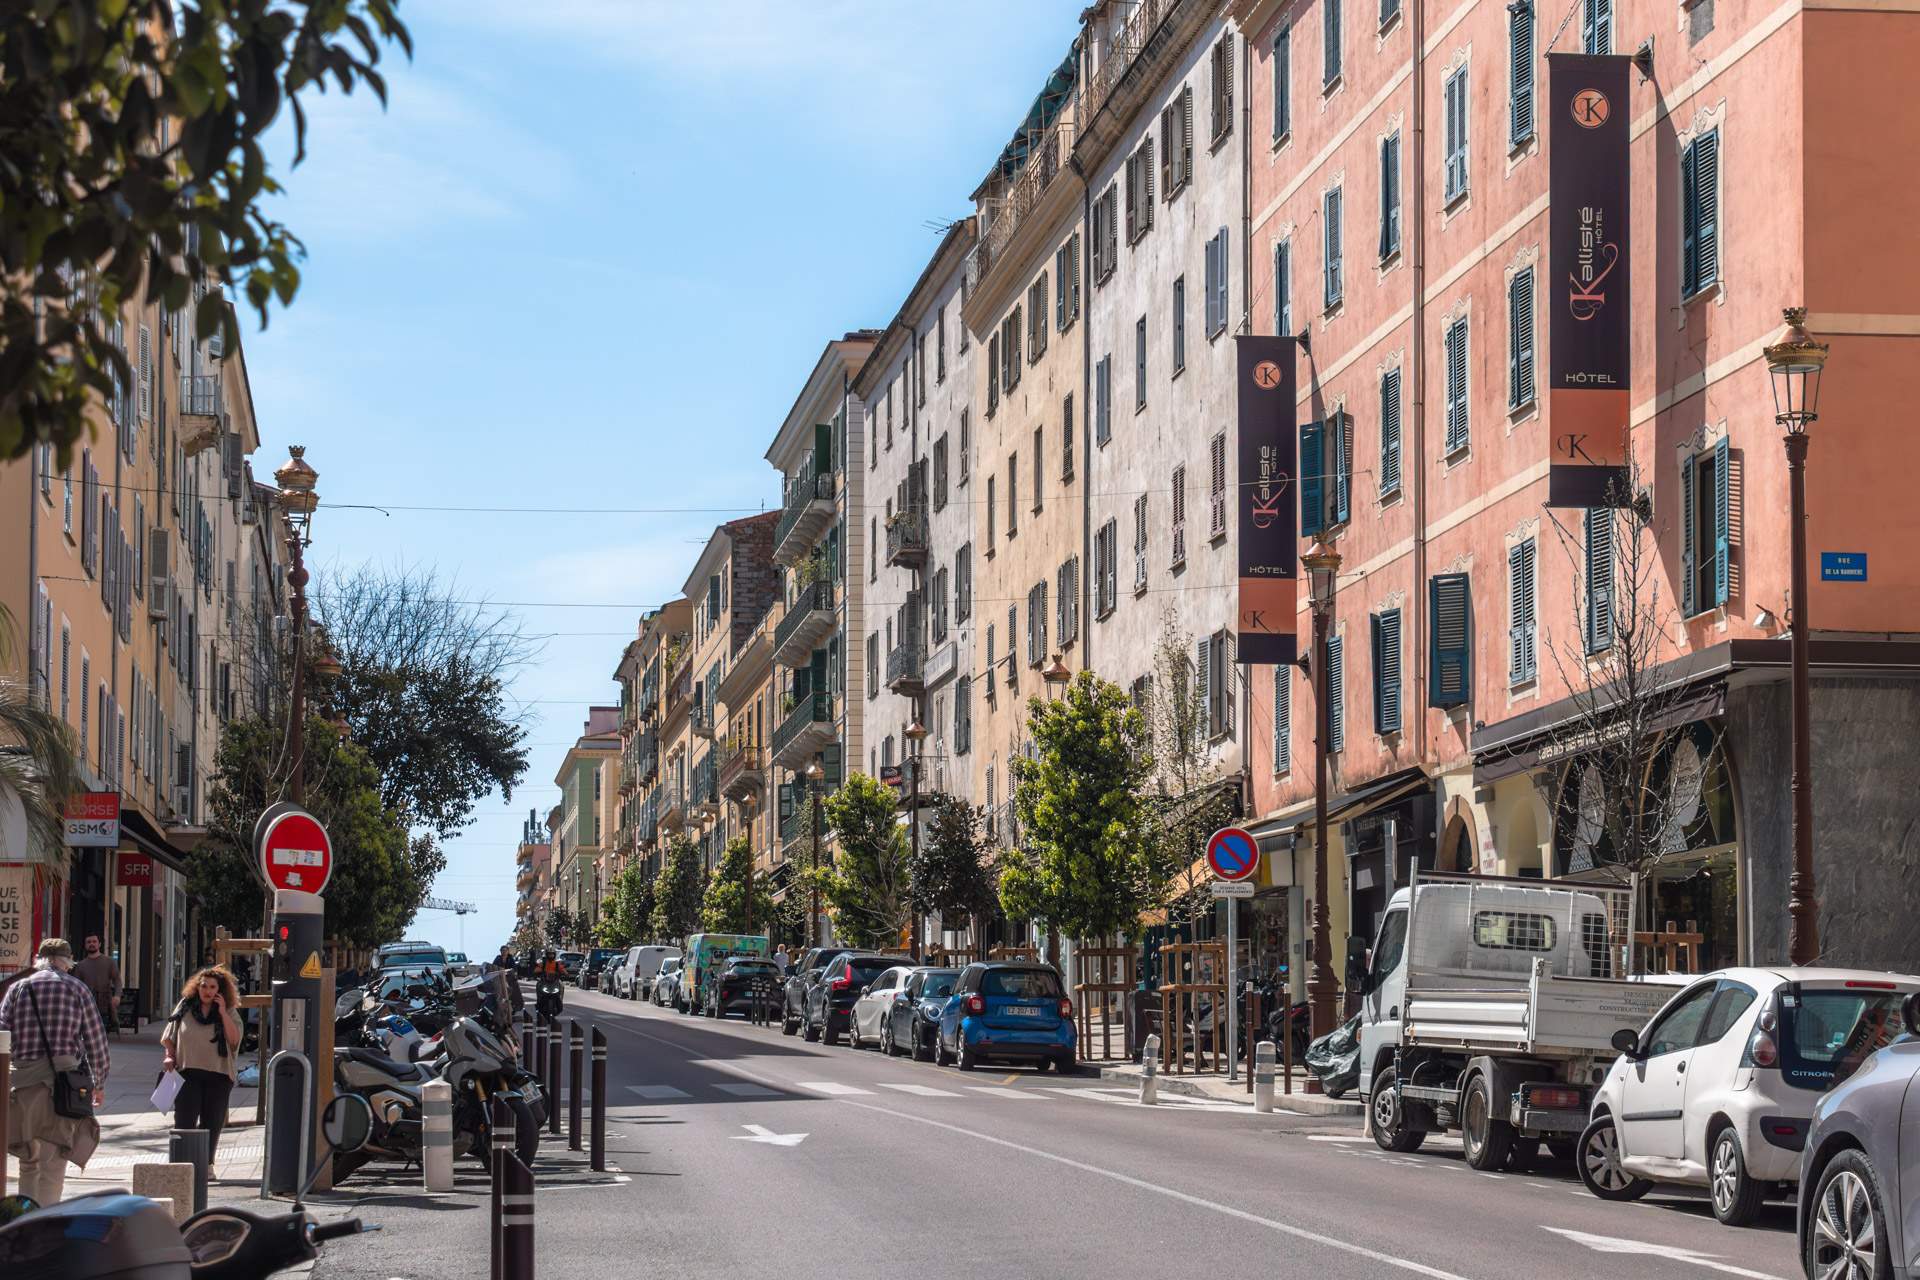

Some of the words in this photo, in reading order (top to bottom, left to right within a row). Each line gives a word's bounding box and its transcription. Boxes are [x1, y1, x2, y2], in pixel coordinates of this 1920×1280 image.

[1573, 97, 1604, 122] K
[1595, 208, 1603, 244] HÔTEL
[1569, 206, 1618, 320] Kallisté
[1565, 372, 1617, 383] HÔTEL
[1249, 565, 1288, 574] HÔTEL
[68, 823, 98, 835] GSM
[124, 863, 150, 875] SFR
[1791, 1070, 1836, 1078] CITROËN
